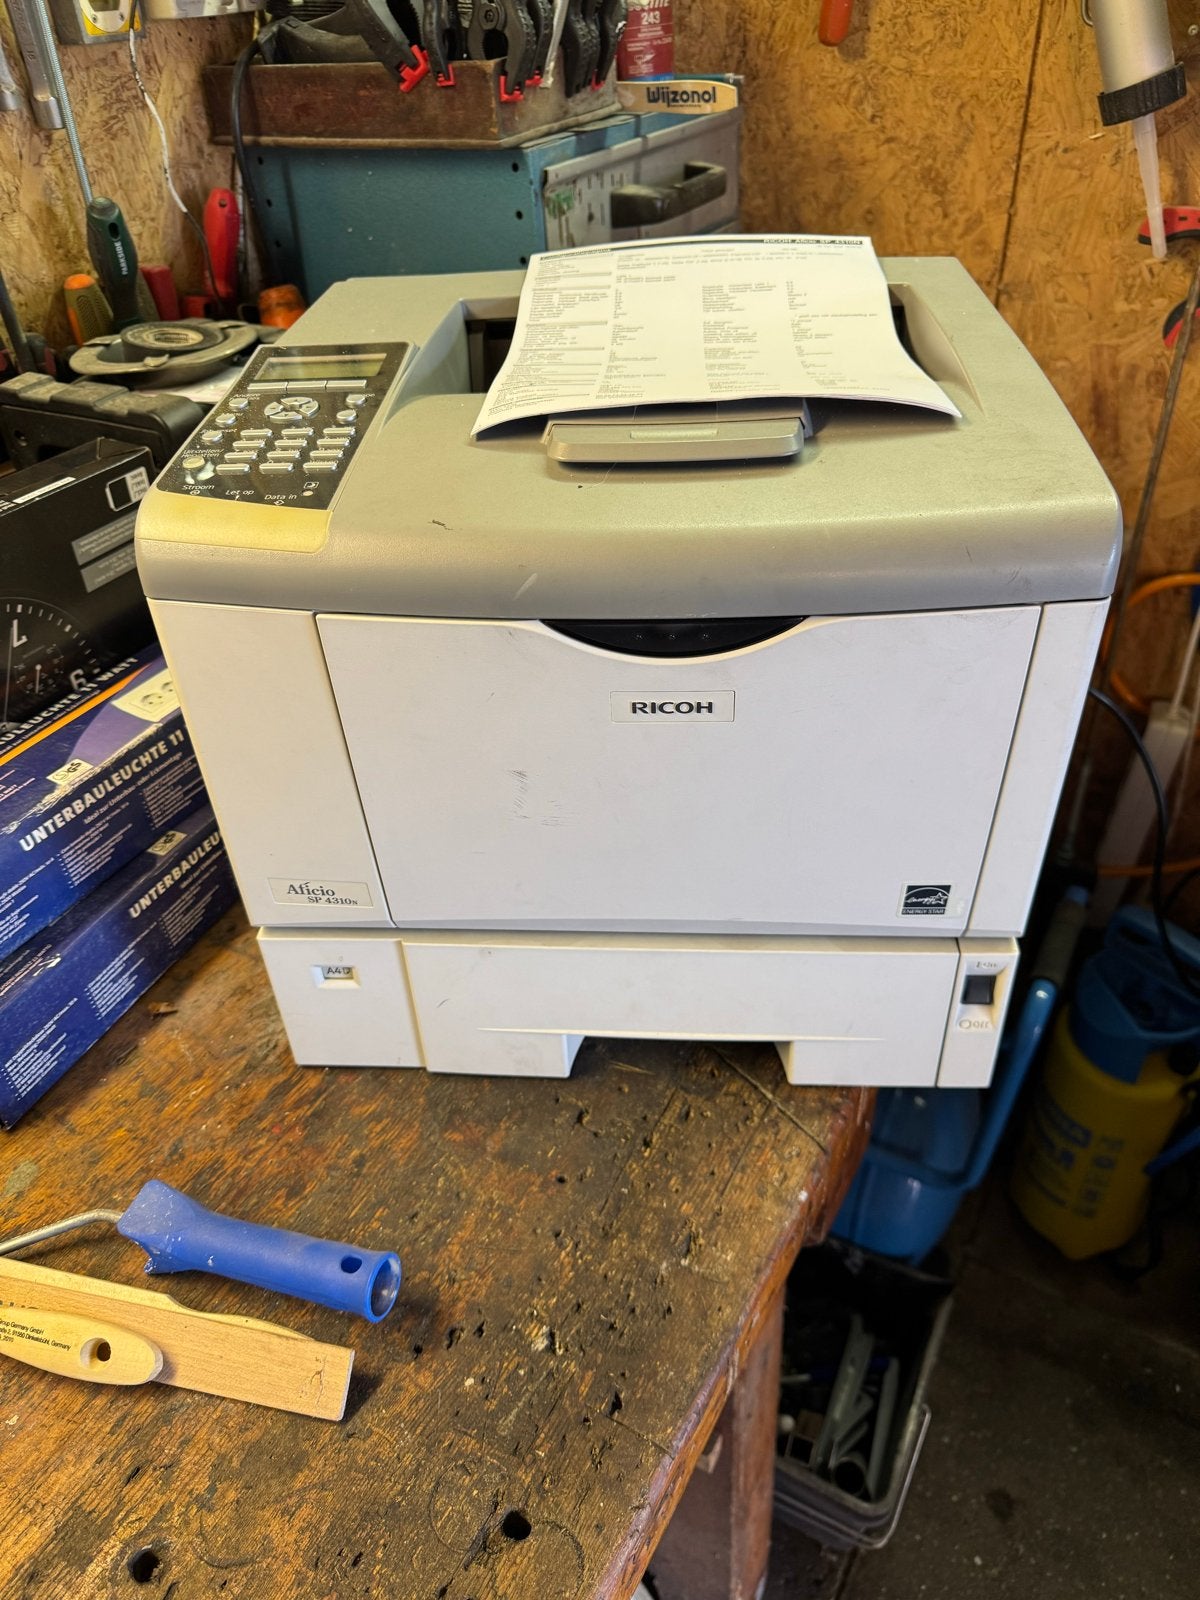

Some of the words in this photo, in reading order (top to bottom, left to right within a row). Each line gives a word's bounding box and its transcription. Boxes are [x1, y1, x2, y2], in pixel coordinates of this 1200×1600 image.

[640, 10, 660, 25] 243
[646, 86, 716, 108] Wijzonol
[96, 658, 138, 681] WATT
[632, 701, 713, 714] RICOH
[18, 740, 168, 853] UNTERBAULEUCHTE
[168, 728, 185, 748] 11
[99, 804, 110, 814] zur
[128, 831, 220, 918] UNTERBAULEU
[287, 882, 336, 897] Aficio
[10, 1321, 29, 1332] Germany
[30, 1326, 44, 1335] GmbH
[51, 1340, 72, 1351] Germany
